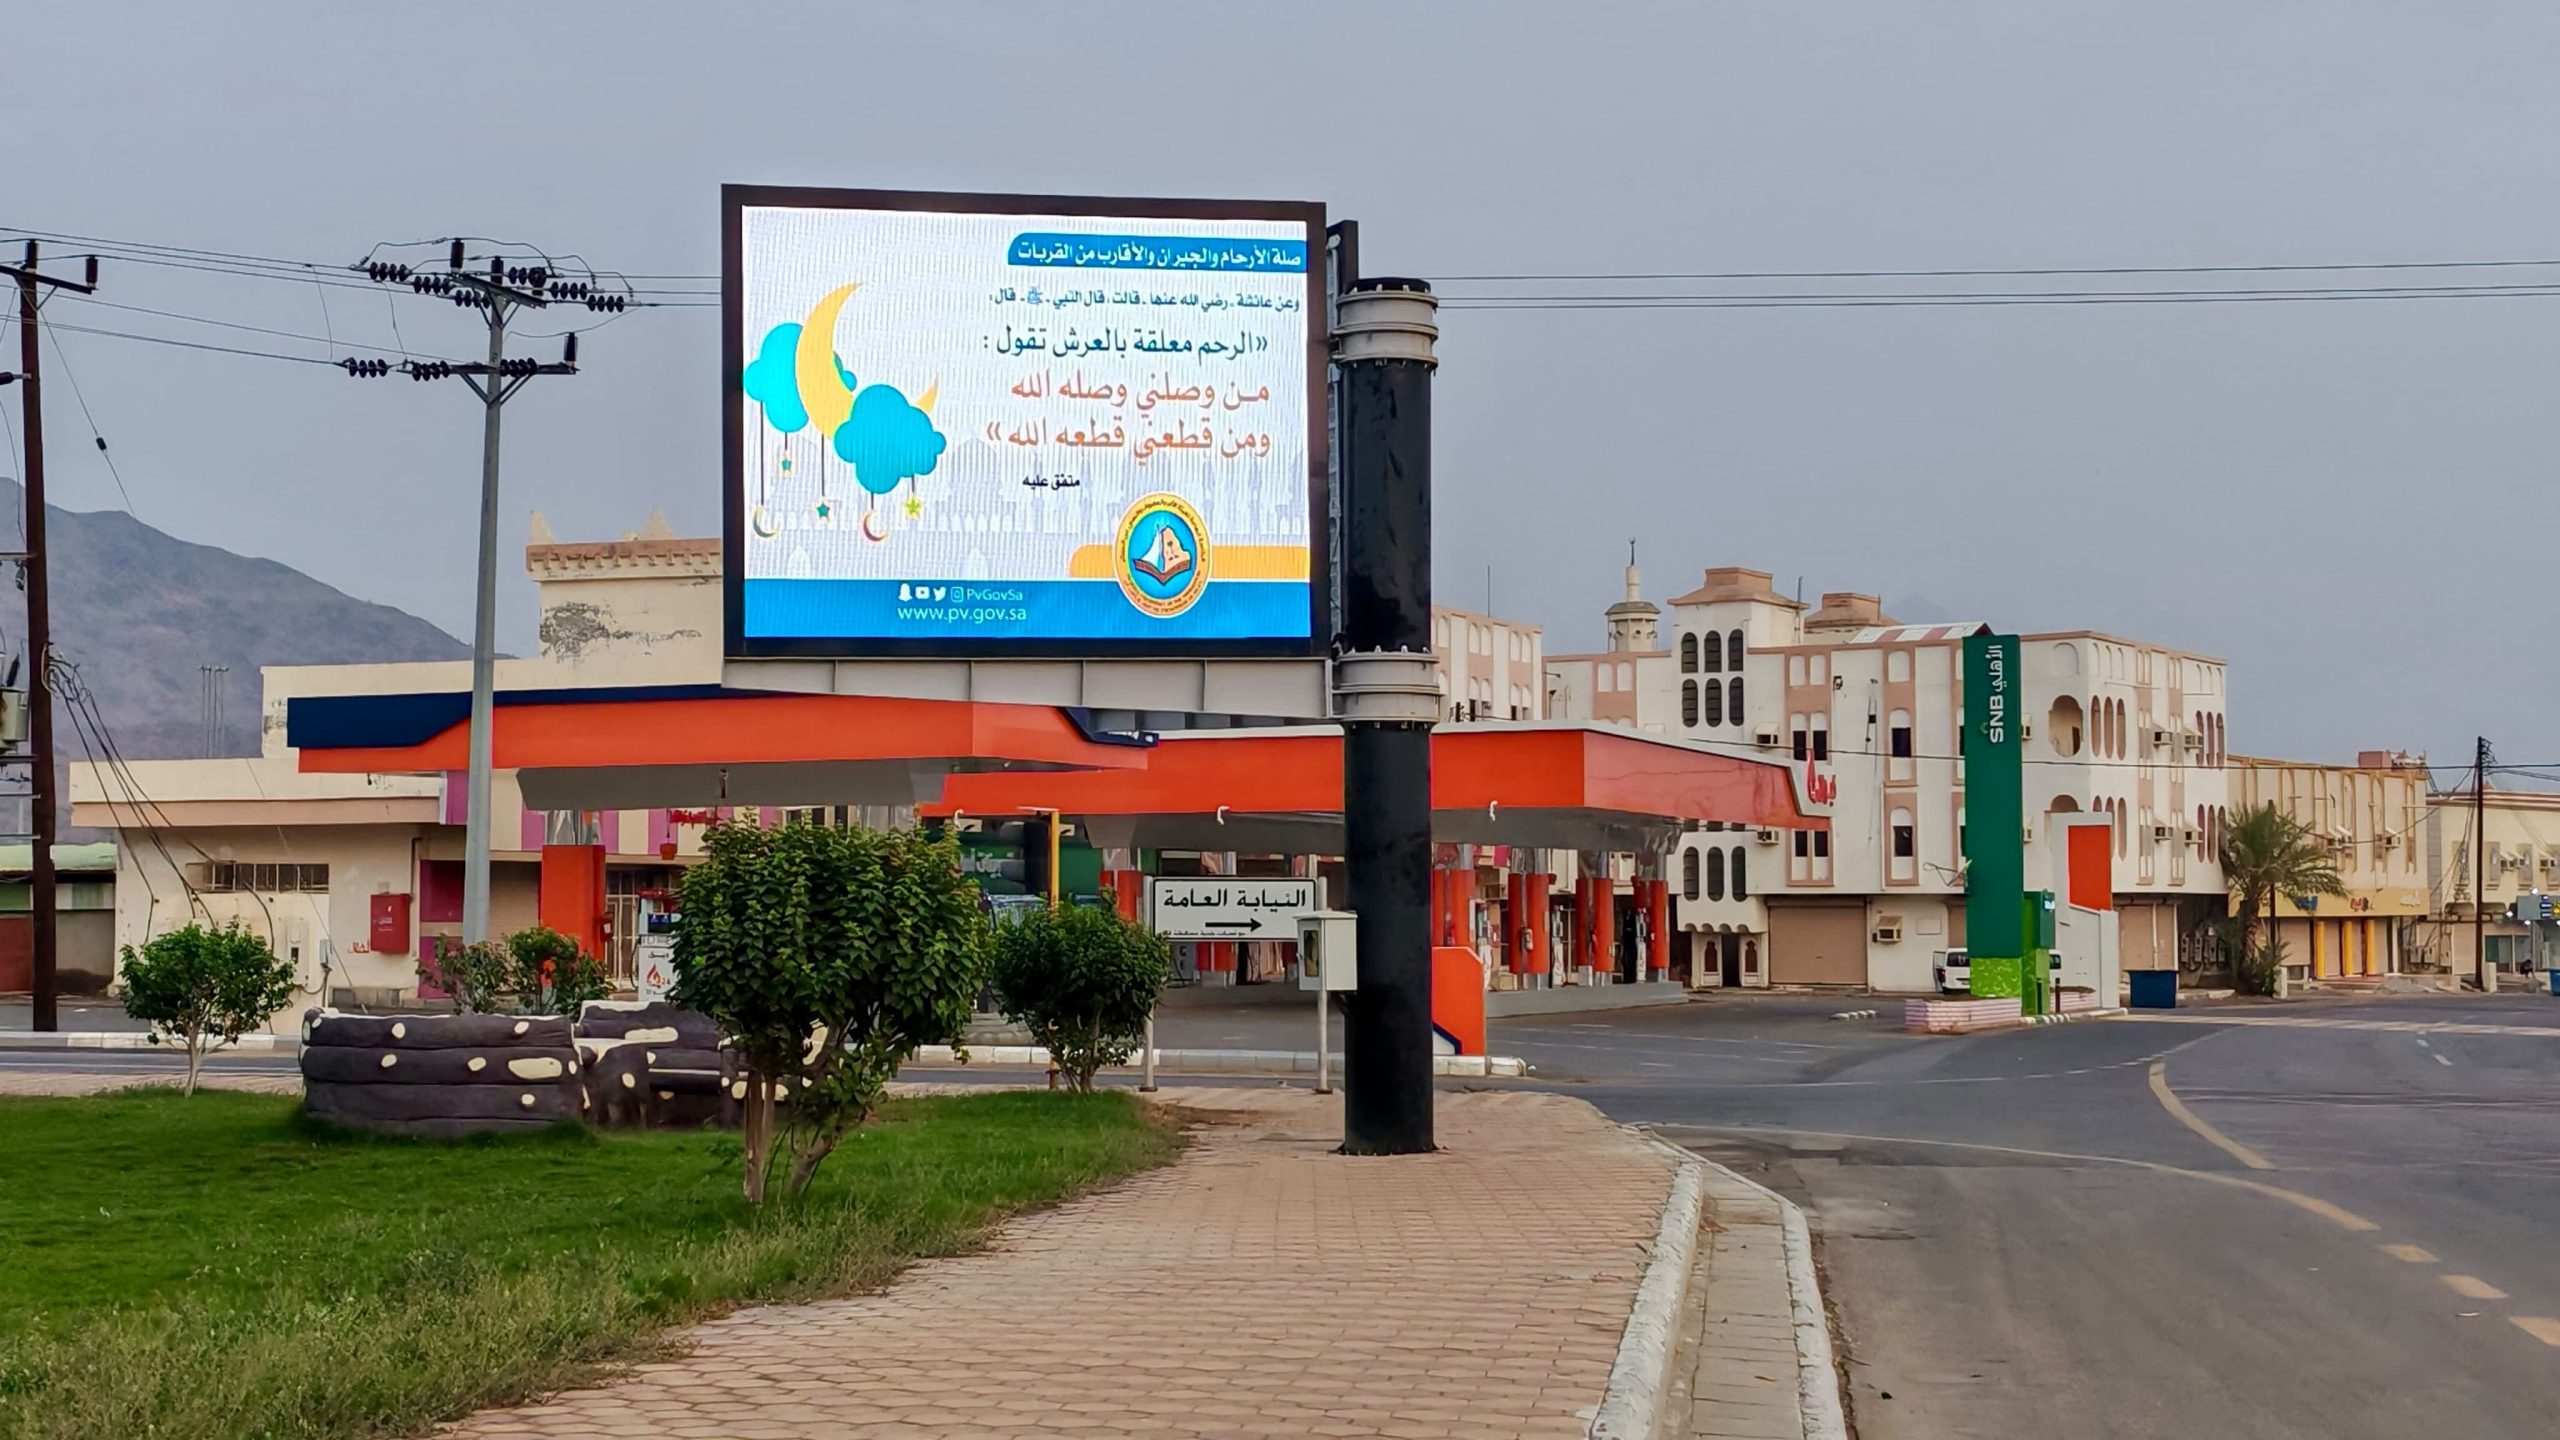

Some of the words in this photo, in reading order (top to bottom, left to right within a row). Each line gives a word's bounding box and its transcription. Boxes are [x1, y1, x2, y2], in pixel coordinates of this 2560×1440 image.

[1017, 241, 1073, 264] القربات
[1075, 245, 1096, 265] من
[1097, 240, 1155, 267] والأقارب
[1157, 248, 1219, 269] والجيران
[1220, 244, 1271, 269] الأرحام
[1272, 248, 1301, 266] صلة
[1053, 290, 1082, 310] النبي
[1083, 289, 1105, 307] قال
[1150, 292, 1177, 306] عنها
[1180, 293, 1199, 306] الله
[1201, 294, 1229, 312] رضي
[1275, 296, 1300, 312] وعن
[1052, 327, 1127, 359] بالعرش
[1133, 328, 1193, 353] معلقة
[1011, 367, 1051, 399] الله
[1058, 368, 1128, 408] وصله
[1136, 371, 1216, 419] وصلني
[1223, 380, 1270, 411] من
[1055, 415, 1125, 448] قطعه
[1133, 416, 1213, 467] قطعني
[1220, 427, 1271, 459] ومن
[1022, 474, 1049, 491] عليه
[1051, 473, 1081, 491] متفق
[966, 588, 1024, 601] PvGovSa
[897, 607, 1027, 624] www.pv.gov.sa
[1984, 644, 2008, 692] الأهلي
[1989, 694, 2004, 744] SNB
[1163, 887, 1228, 908] العامة
[1236, 888, 1306, 913] النيابة
